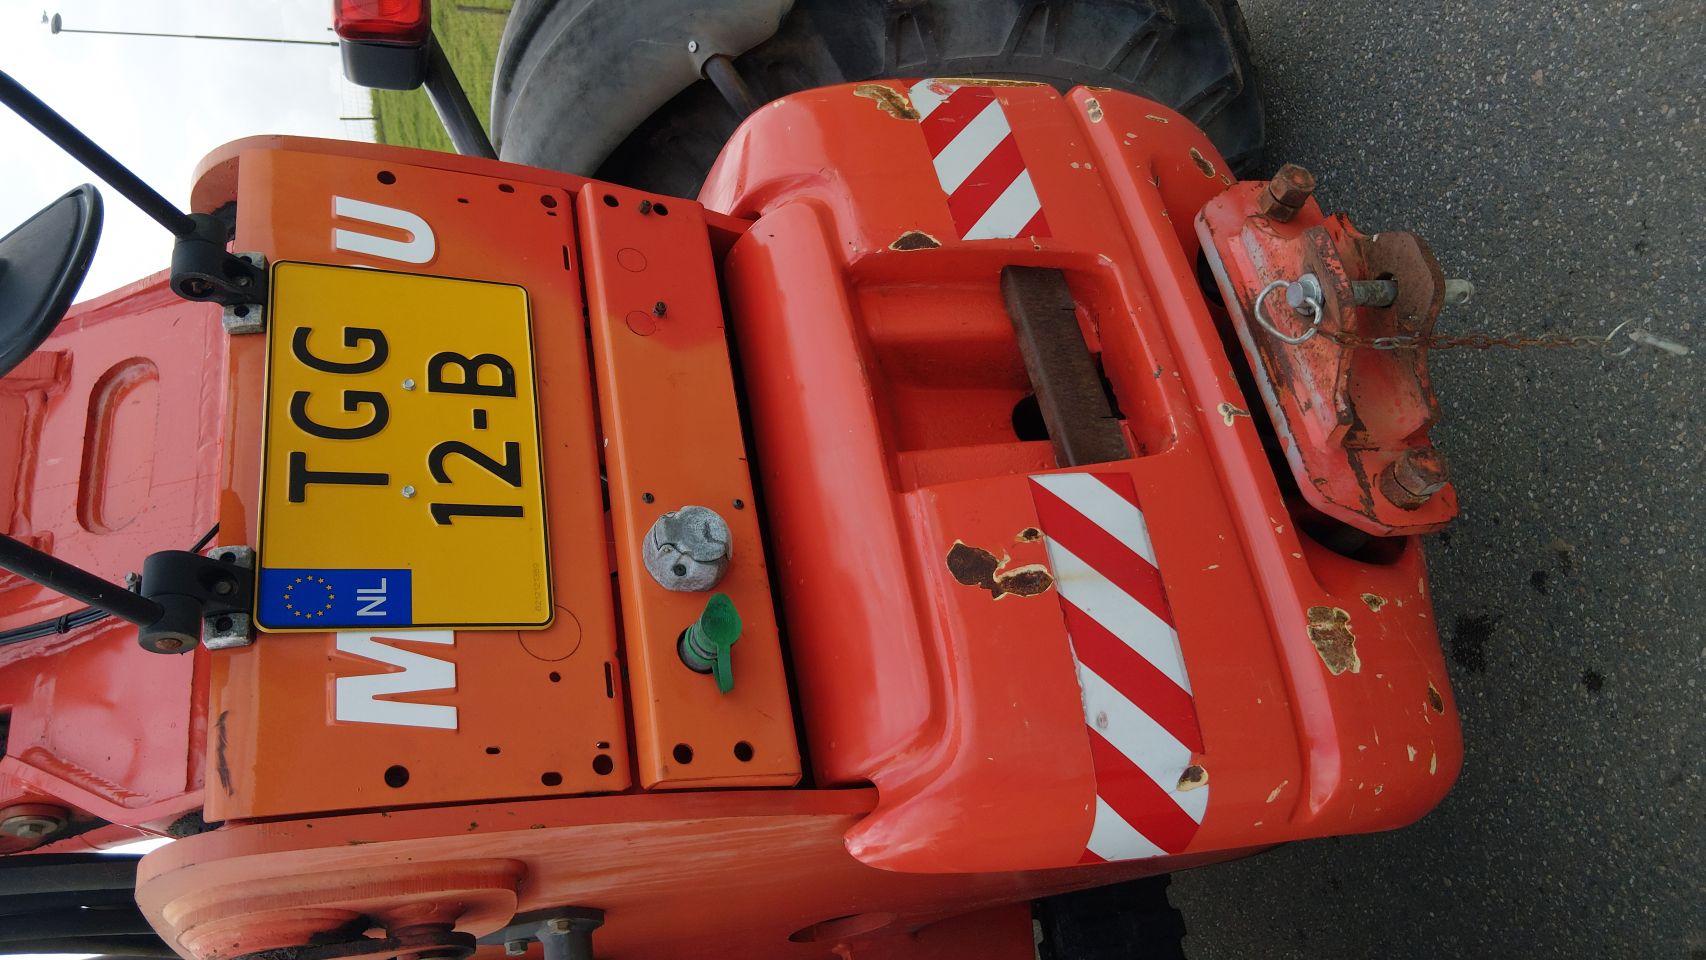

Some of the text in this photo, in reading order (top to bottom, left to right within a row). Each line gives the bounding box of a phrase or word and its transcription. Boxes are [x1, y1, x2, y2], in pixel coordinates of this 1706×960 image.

[288, 326, 390, 503] TGG
[427, 351, 524, 526] 12-B
[356, 577, 387, 616] NL
